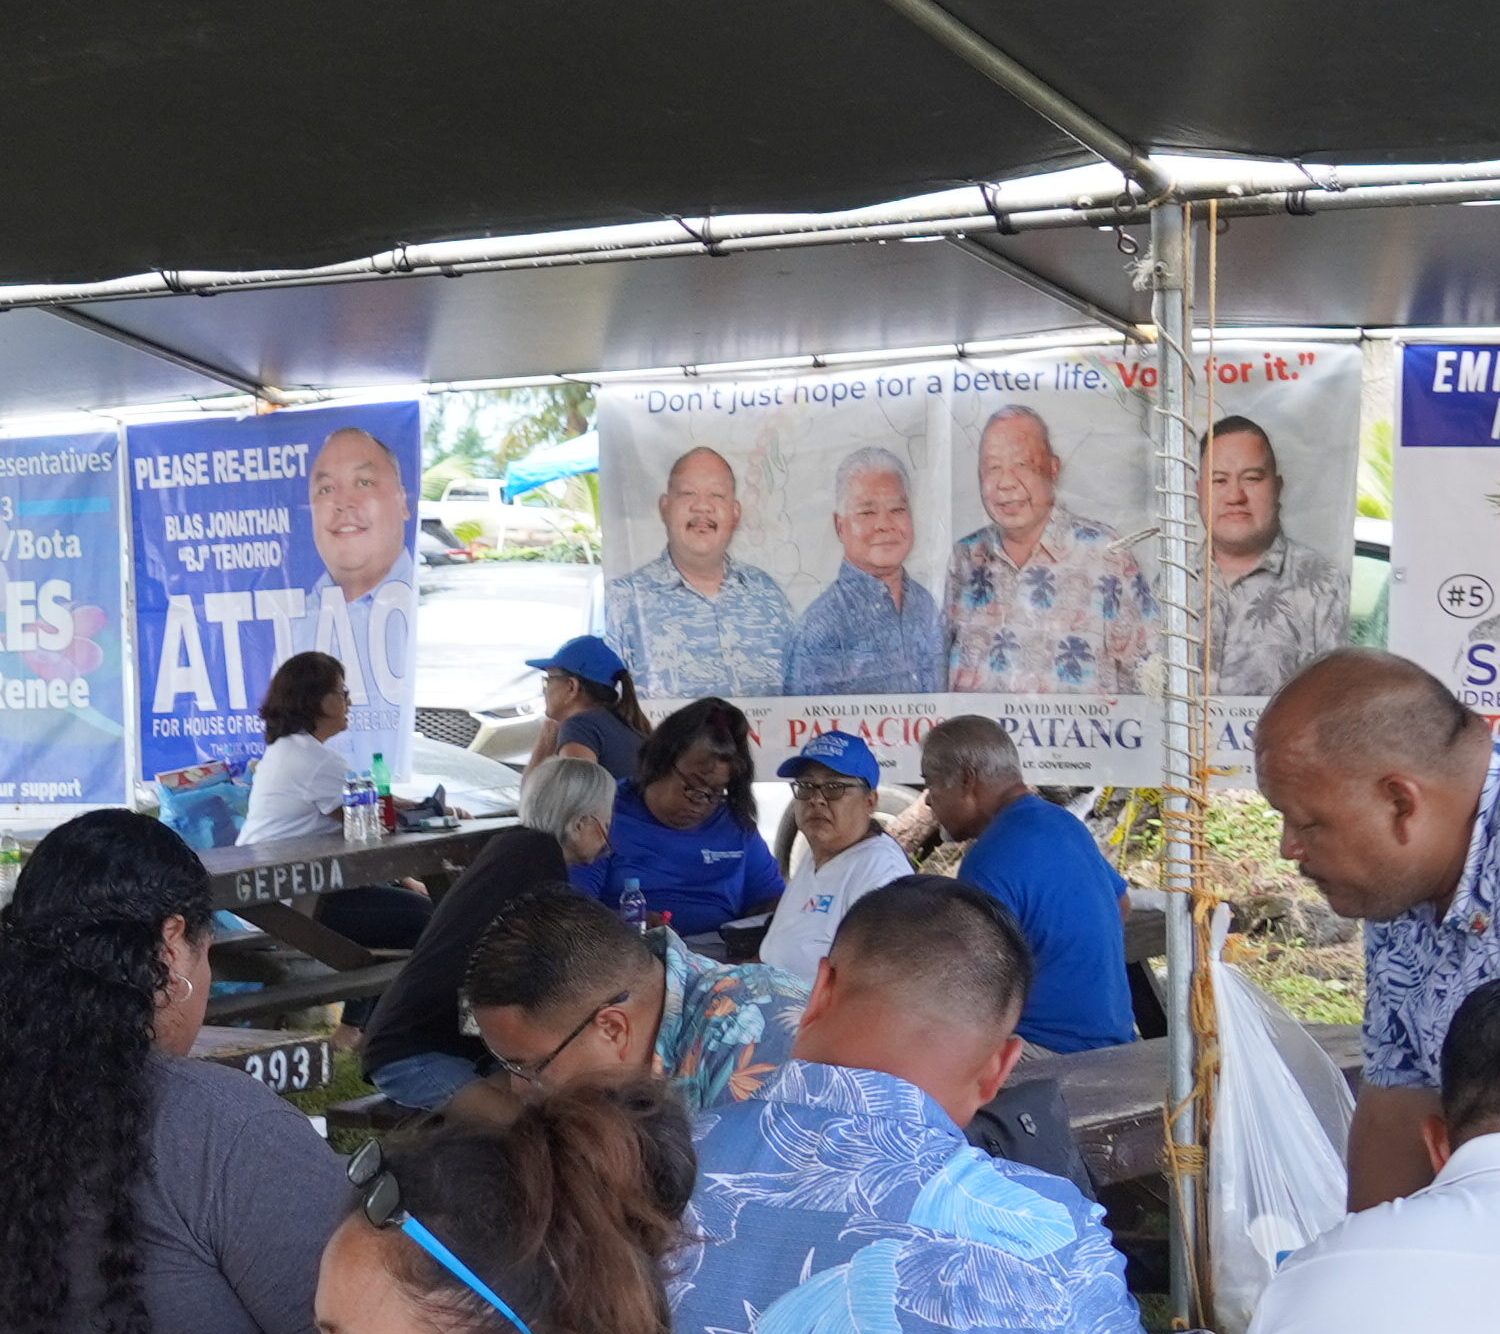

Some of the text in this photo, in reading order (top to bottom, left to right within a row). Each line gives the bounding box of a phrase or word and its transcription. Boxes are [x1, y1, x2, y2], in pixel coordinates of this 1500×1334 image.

[729, 382, 783, 415] just
[793, 379, 866, 407] hope
[877, 373, 915, 398] for
[927, 376, 942, 394] a
[954, 364, 1044, 393] better
[1055, 362, 1108, 392] life.
[1203, 356, 1253, 386] for
[134, 444, 309, 490] PLEASE RE-ELECT
[2, 496, 14, 521] 3
[165, 507, 291, 542] BLAS JONATHAN
[212, 540, 282, 571] TENORIO
[1446, 585, 1484, 608] #5
[802, 702, 937, 717] ARNOLD INDALECIO
[1004, 703, 1110, 716] DAVID MUNDO
[153, 718, 178, 738] FOR
[183, 716, 225, 737] HOUSE
[227, 716, 244, 735] OF
[998, 717, 1144, 750] PATANG
[20, 778, 82, 802] support
